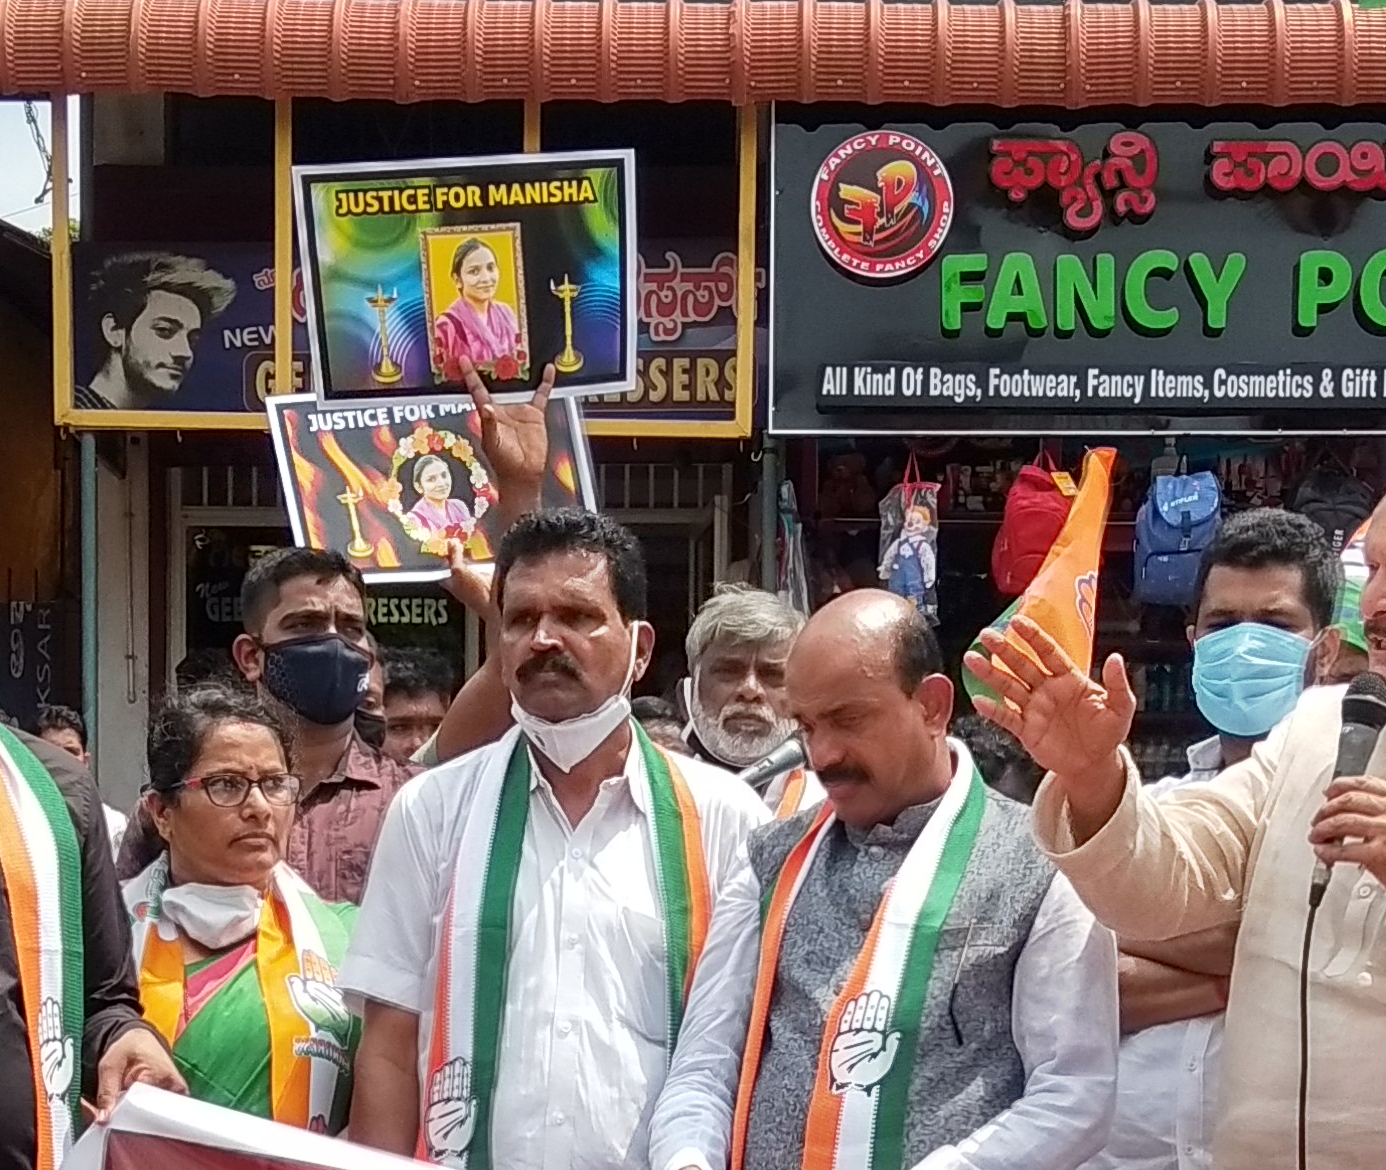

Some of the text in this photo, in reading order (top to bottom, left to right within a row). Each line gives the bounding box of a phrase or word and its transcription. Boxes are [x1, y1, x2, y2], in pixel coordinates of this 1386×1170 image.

[820, 135, 944, 181] FANCY POINT
[336, 179, 595, 214] JUSTICE FOR MANISHA
[816, 201, 951, 272] COMPLETE FANCY SHOP
[939, 250, 1248, 337] FANCY
[822, 366, 848, 395] All
[854, 367, 896, 396] Kind
[902, 367, 924, 396] Of
[929, 367, 982, 402] Bags,
[989, 368, 1080, 402] Footwear,
[1087, 368, 1144, 403] Fancy
[1150, 369, 1210, 402] Items,
[1213, 368, 1313, 398] Cosmetics
[1319, 369, 1334, 398] &
[1341, 368, 1376, 398] Gift
[308, 408, 391, 432] JUSTICE
[365, 597, 448, 626] RESSERS
